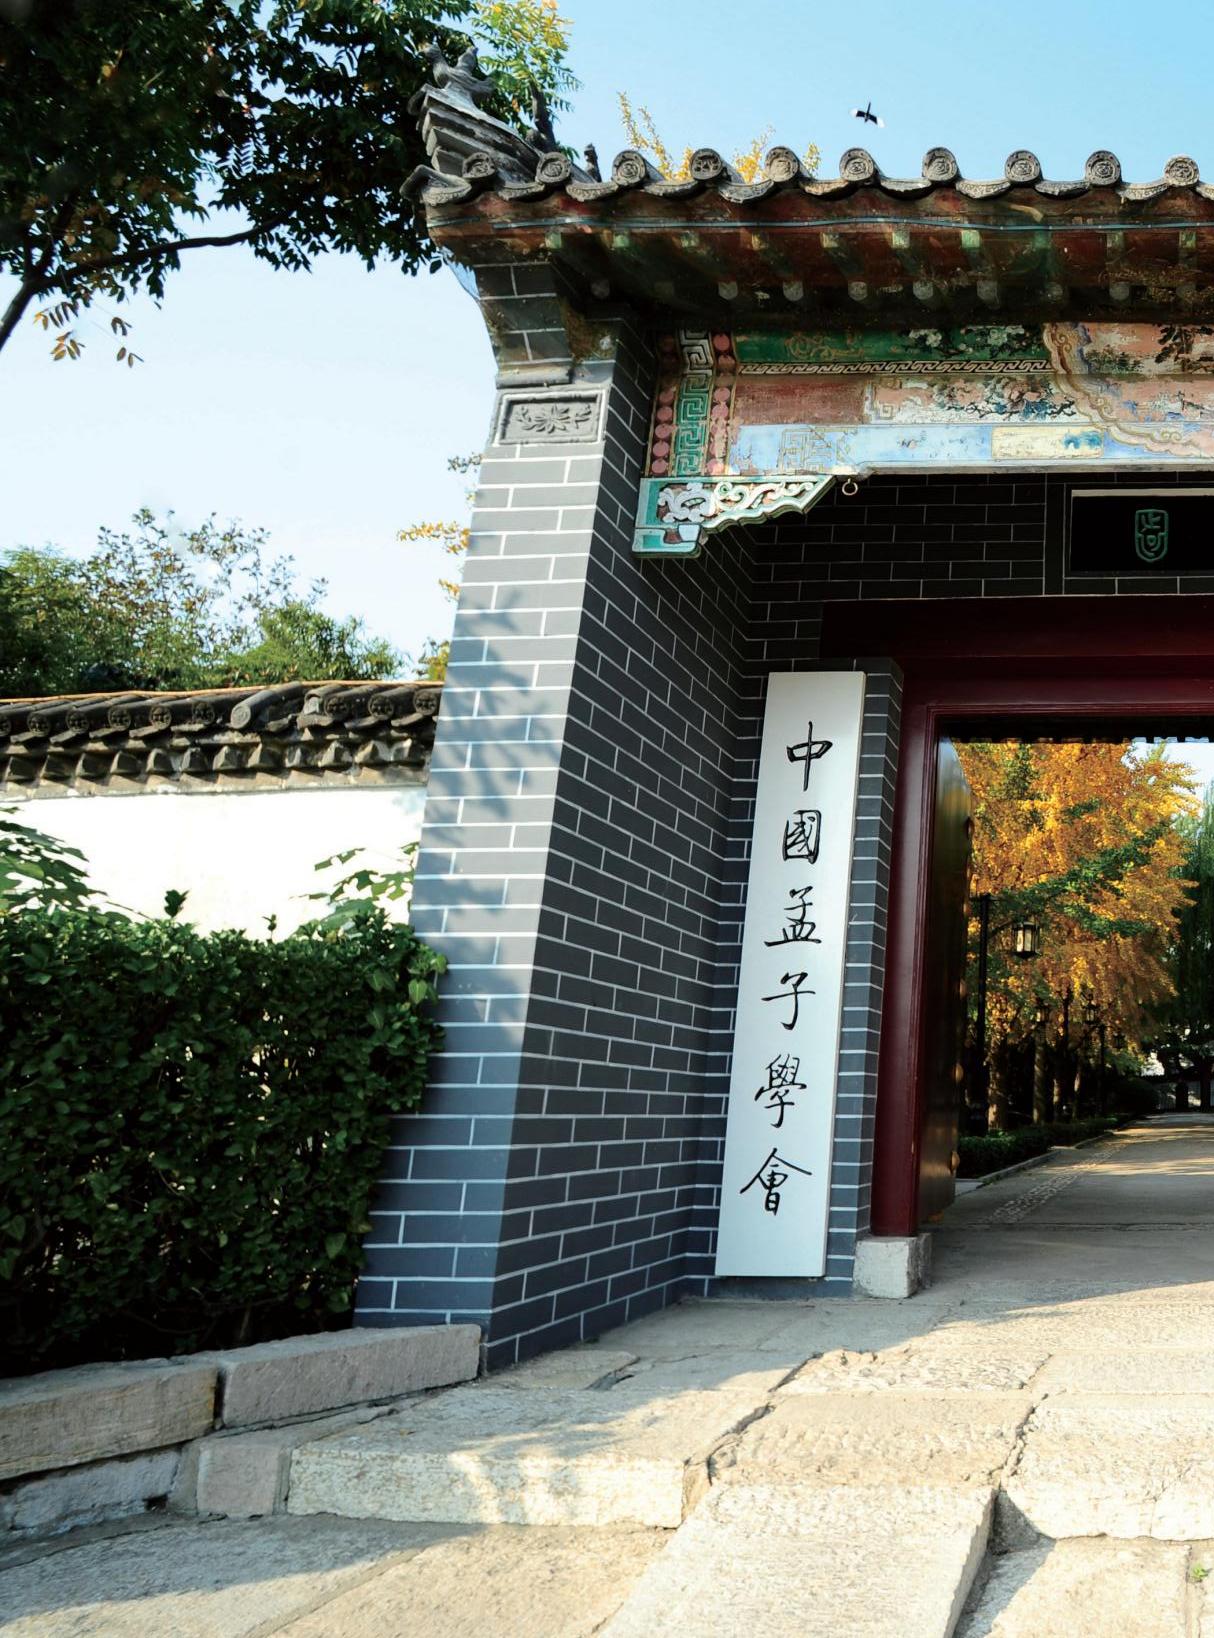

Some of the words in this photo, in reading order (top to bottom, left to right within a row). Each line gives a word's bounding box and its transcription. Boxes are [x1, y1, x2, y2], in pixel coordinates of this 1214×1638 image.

[739, 720, 833, 1217] 中國孟子學會
